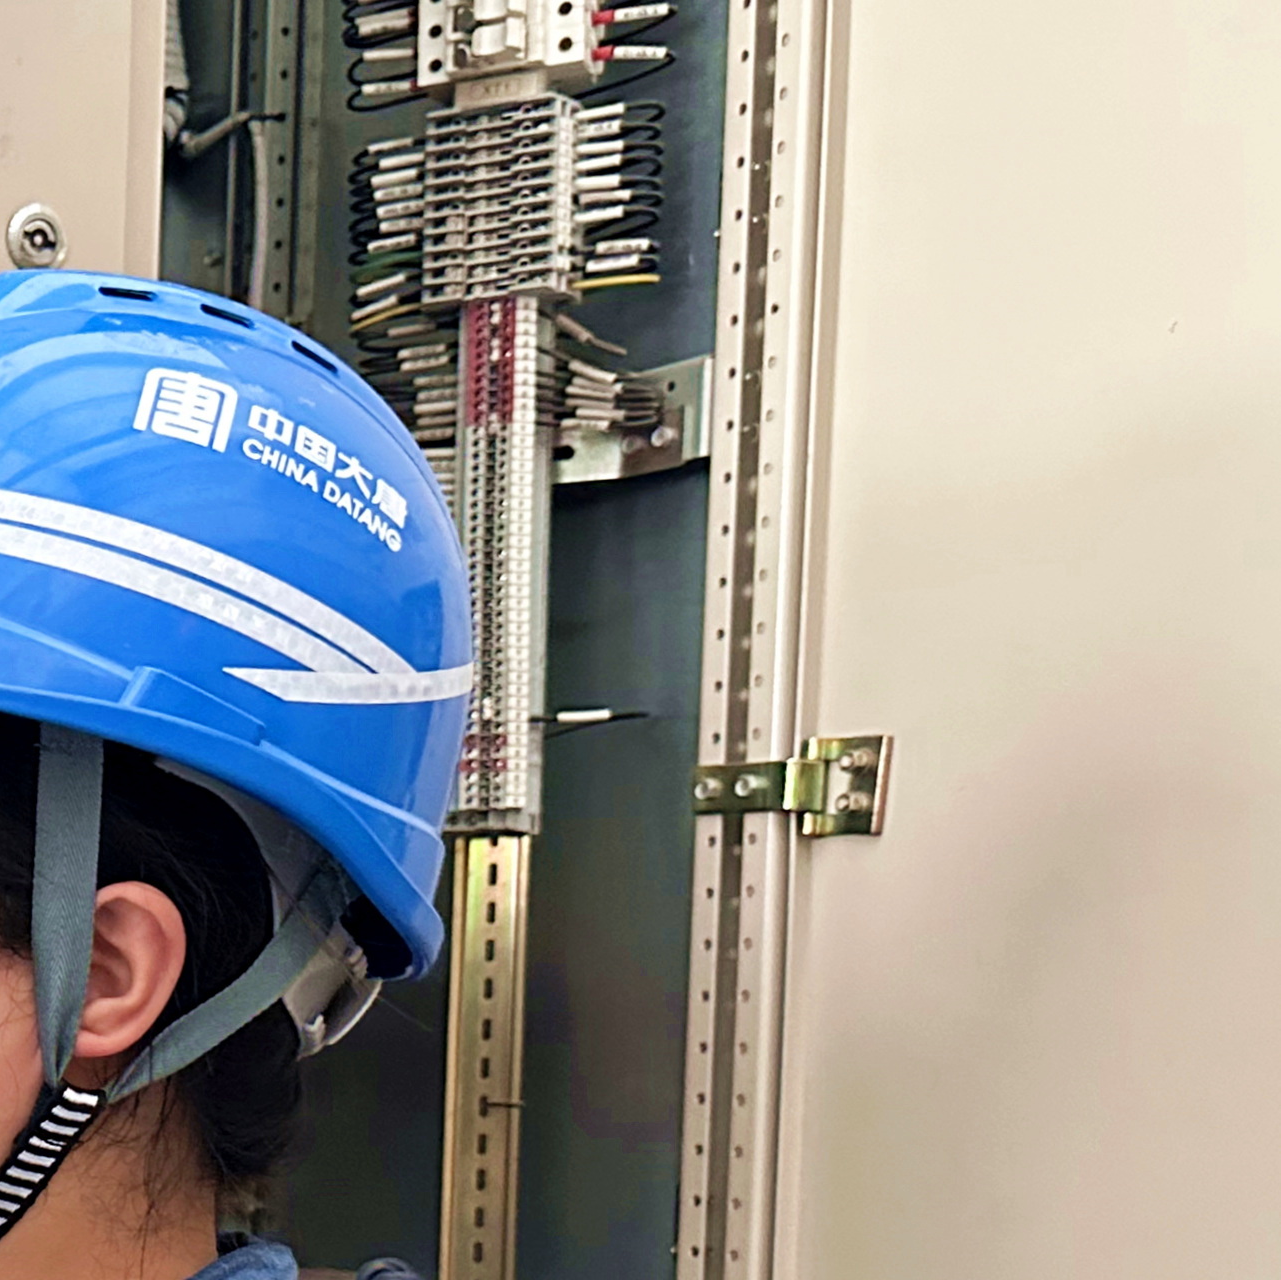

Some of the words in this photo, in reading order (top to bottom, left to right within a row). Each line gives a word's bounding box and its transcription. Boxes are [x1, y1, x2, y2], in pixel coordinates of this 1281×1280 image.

[242, 438, 319, 493] CHINA
[322, 480, 402, 552] DATANG
[247, 404, 408, 529] 中国大唐
